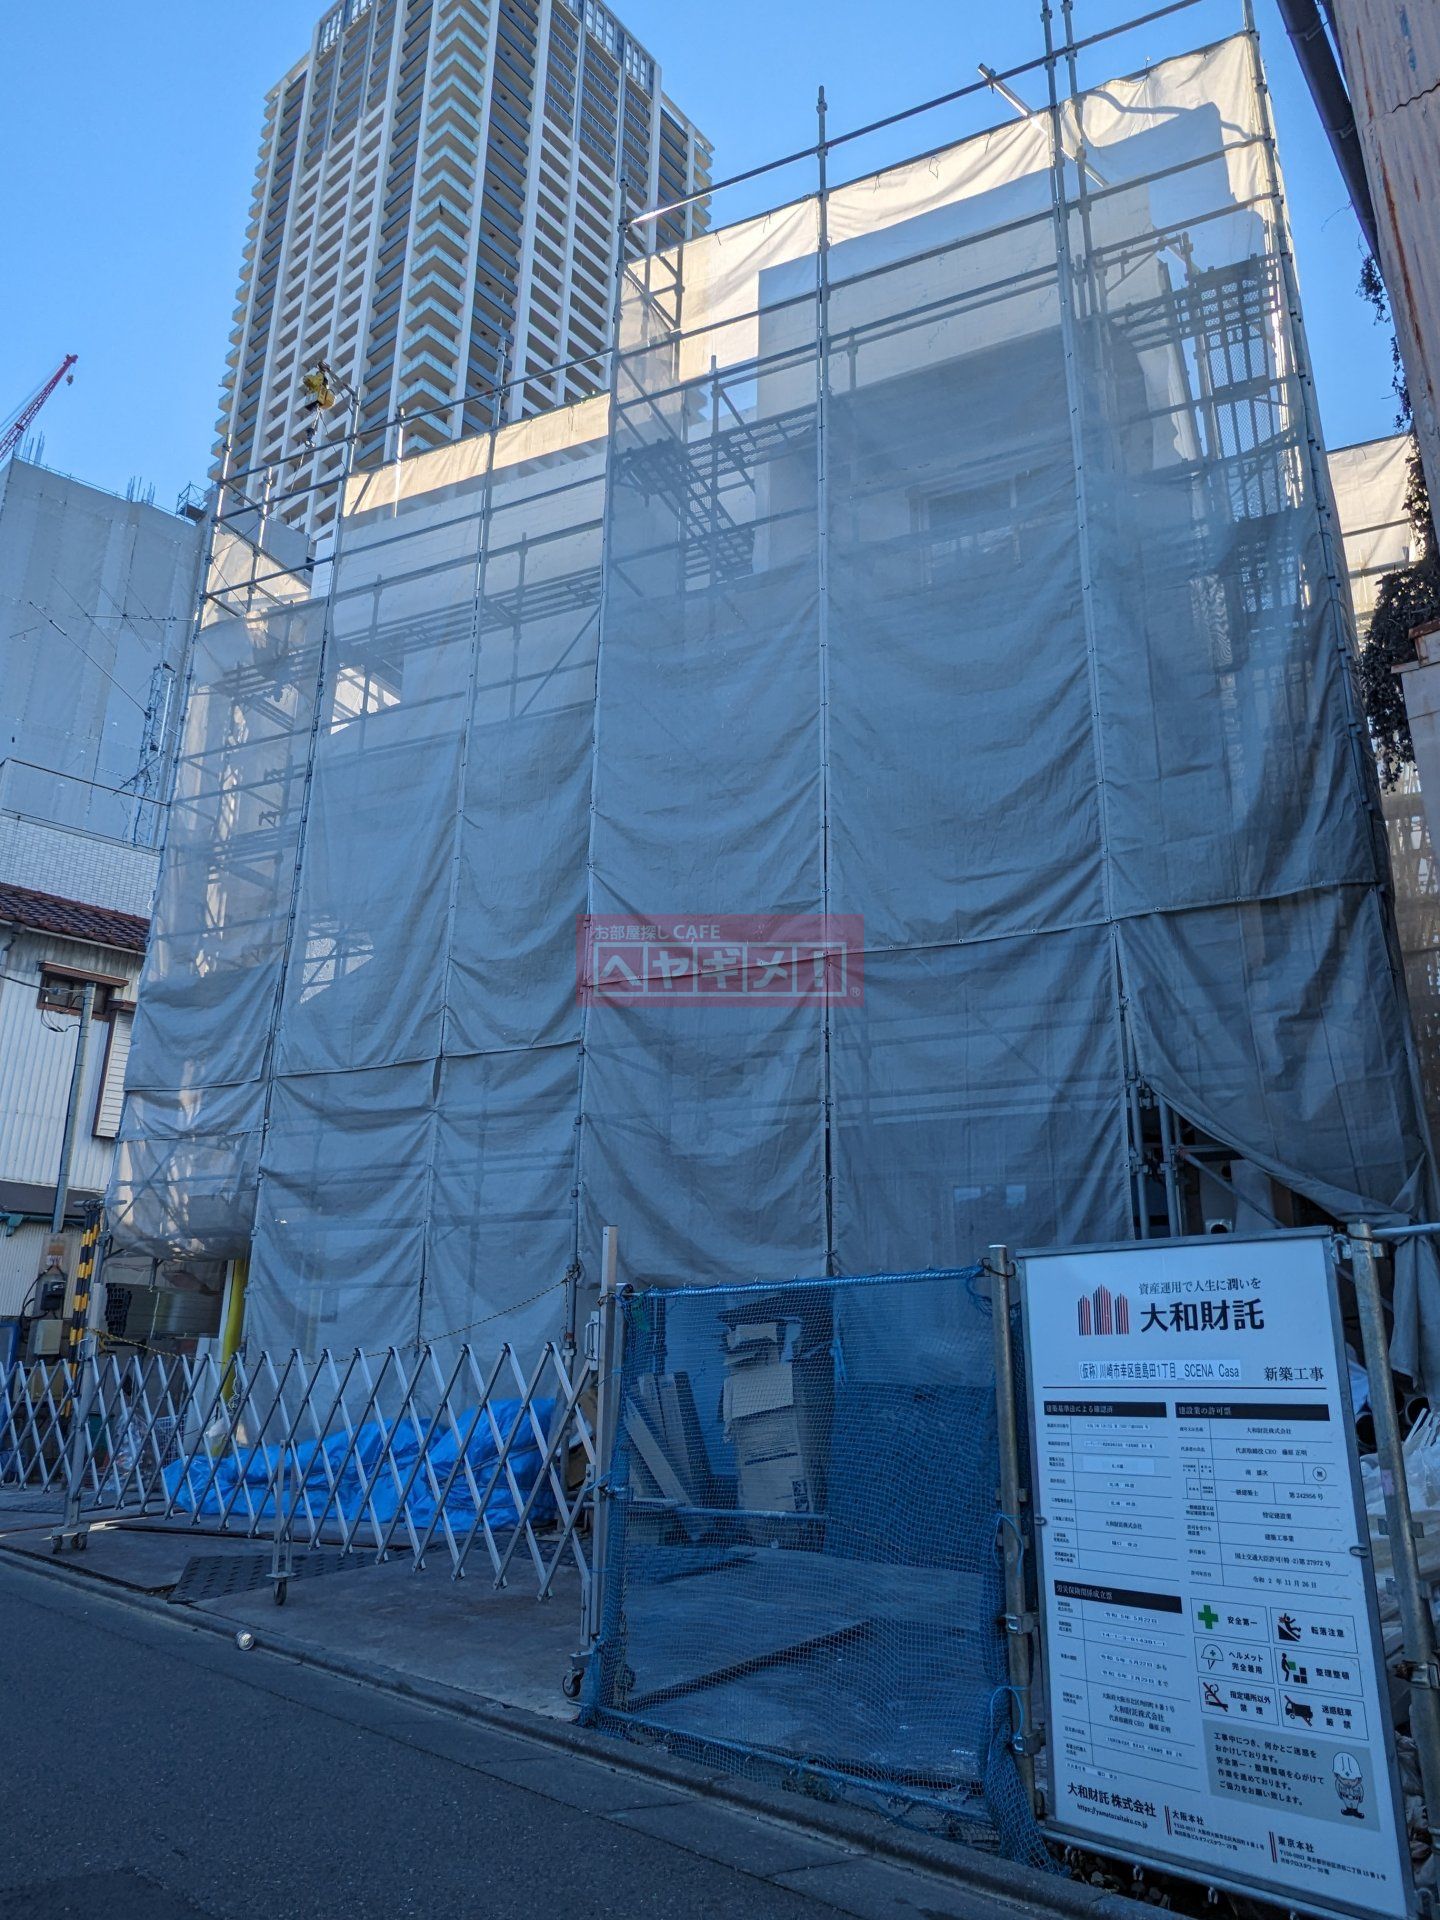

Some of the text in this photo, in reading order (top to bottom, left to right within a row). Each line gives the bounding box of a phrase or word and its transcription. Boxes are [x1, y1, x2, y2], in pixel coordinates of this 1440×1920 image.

[1138, 1276, 1262, 1296] 資産運用で人生に潤いを
[1140, 1297, 1265, 1333] 大和財託
[1218, 1364, 1240, 1378] Casa
[1263, 1366, 1325, 1382] 新築工事
[1227, 1615, 1258, 1626] 安全第一
[1310, 1626, 1345, 1638] 転落注意
[1229, 1651, 1264, 1663] ヘルメット
[1067, 1781, 1157, 1818] 大和財託 株式会社
[1172, 1809, 1205, 1826] 大阪本社
[1278, 1836, 1315, 1853] 東京本社
